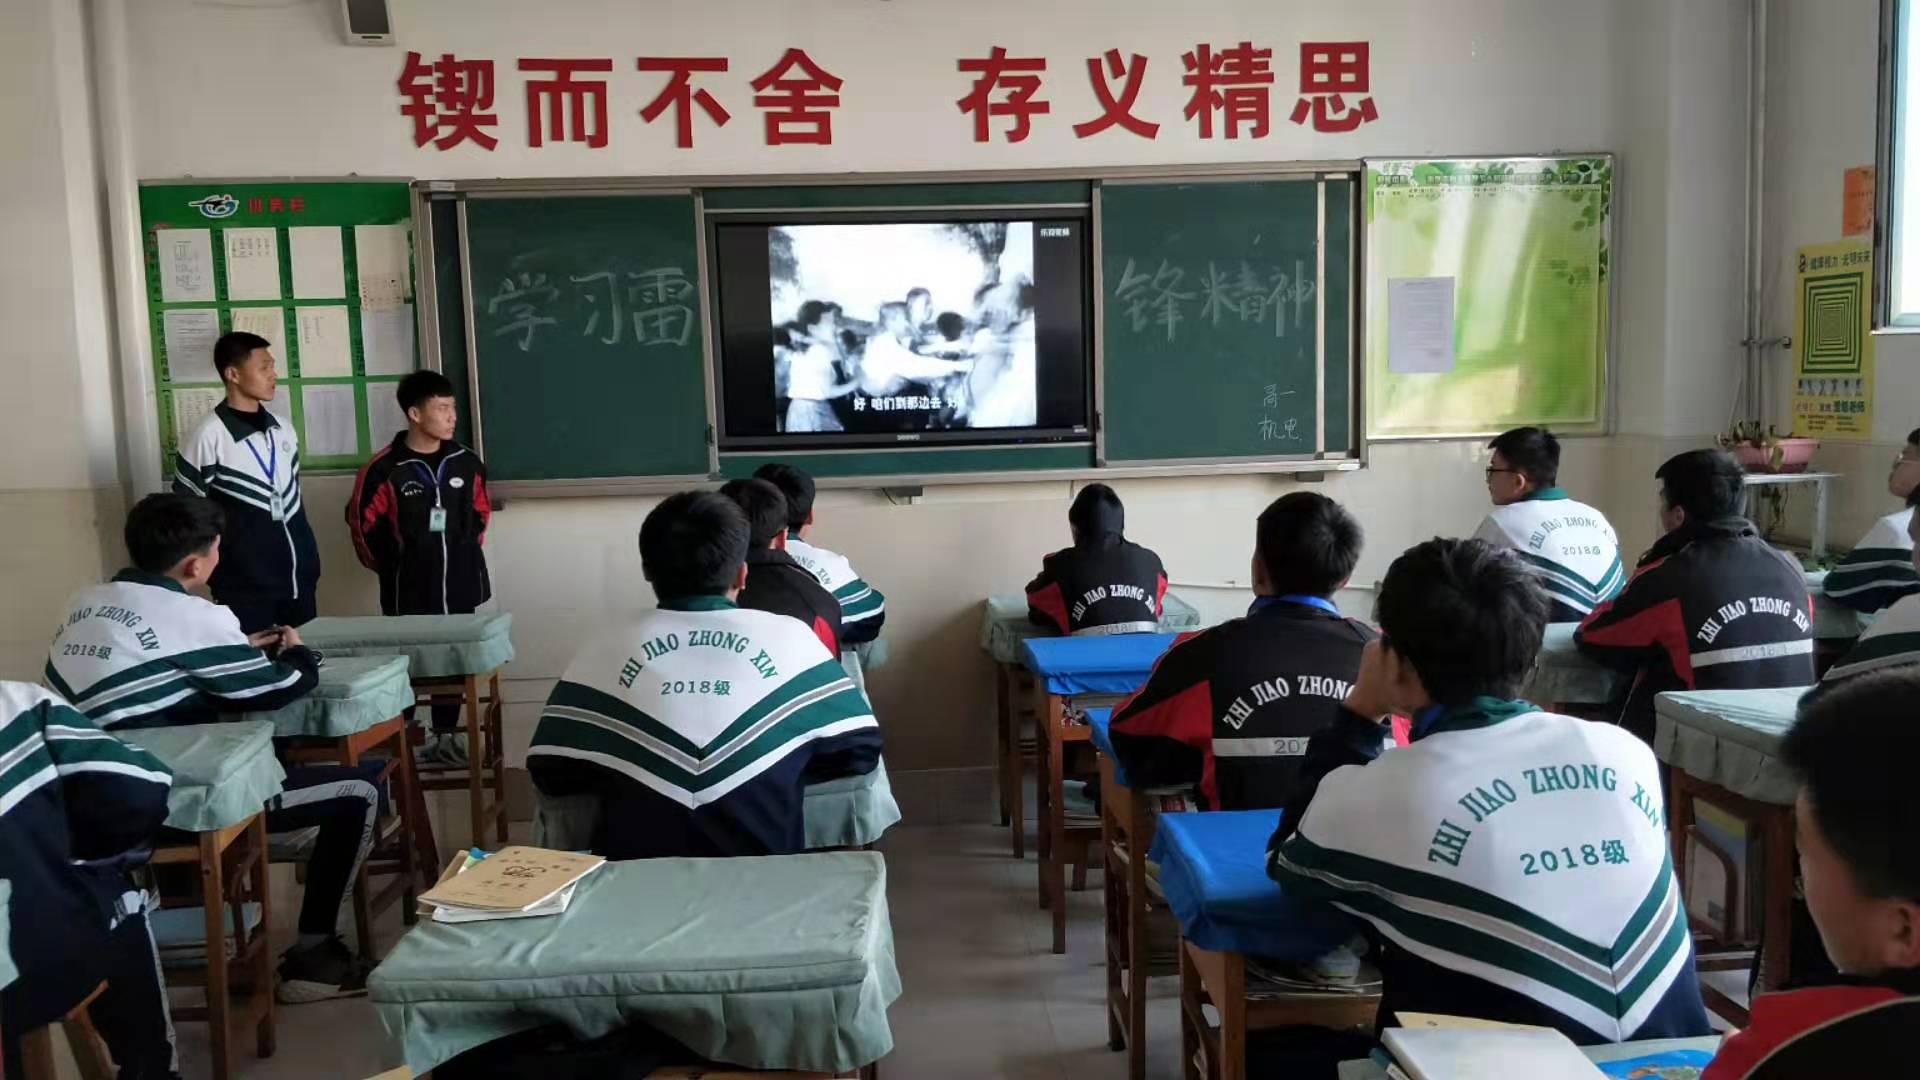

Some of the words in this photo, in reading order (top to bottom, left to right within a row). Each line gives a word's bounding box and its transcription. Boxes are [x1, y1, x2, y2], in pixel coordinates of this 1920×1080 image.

[398, 47, 844, 151] 锲而不舍
[956, 41, 1378, 143] 存义精思
[488, 267, 694, 351] 学习雷
[1114, 257, 1316, 342] 锋精神
[1258, 414, 1302, 440] 机电
[1072, 601, 1086, 621] ZHI
[1083, 586, 1107, 605] JIAO
[1109, 584, 1145, 601] ZHONG
[1697, 616, 1722, 645] ZHI
[1718, 599, 1746, 624] JIAO
[1749, 596, 1791, 616] ZHONG
[1792, 608, 1810, 633] XIN
[63, 643, 113, 660] 2018级
[95, 605, 142, 628] ZHONG
[135, 626, 161, 651] XIN
[618, 656, 644, 689] ZHI
[641, 633, 680, 661] JIAO
[688, 630, 750, 653] ZHONG
[749, 649, 779, 680] XIN
[660, 680, 732, 696] 2018级
[1222, 697, 1254, 731] ZHI
[1250, 677, 1290, 706] JIAO
[1427, 819, 1472, 867] ZHI
[1457, 778, 1518, 823] JIAO
[1522, 764, 1617, 795] ZHONG
[1629, 781, 1660, 828] XIN
[1519, 839, 1630, 876] 2018级
